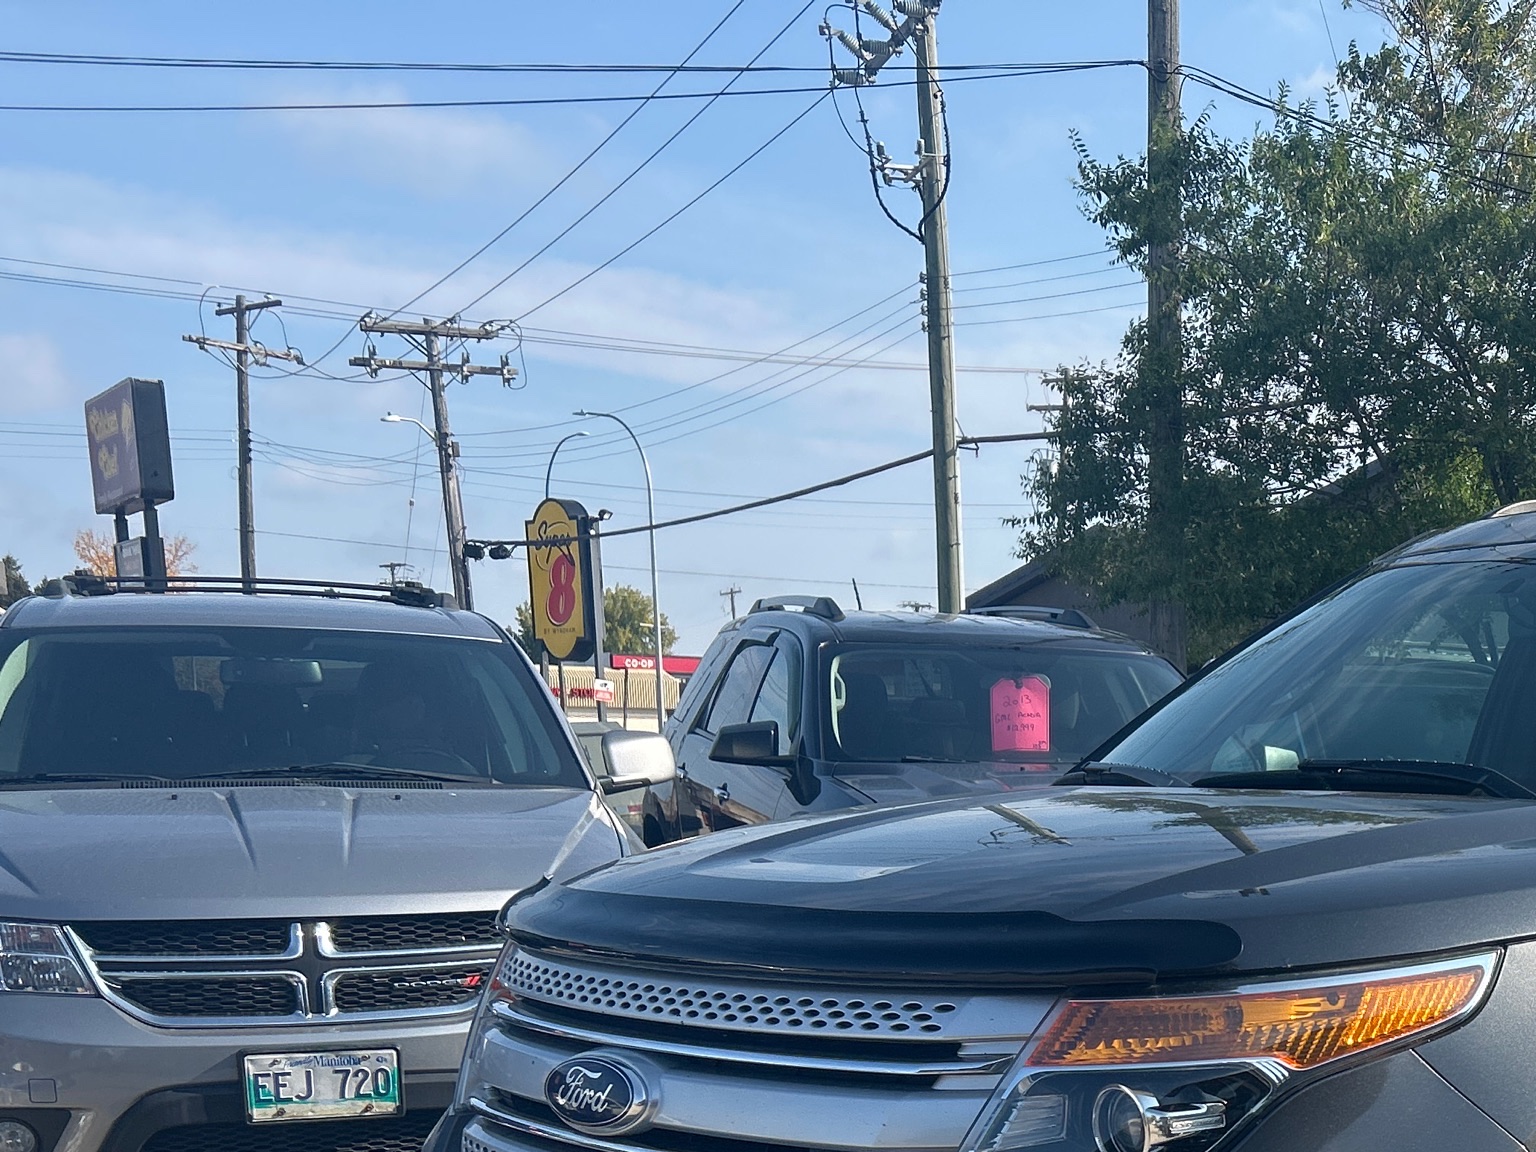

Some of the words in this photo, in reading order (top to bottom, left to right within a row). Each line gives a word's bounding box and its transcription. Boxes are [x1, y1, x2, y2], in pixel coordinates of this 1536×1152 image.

[535, 520, 575, 565] Super
[546, 553, 576, 626] 8
[1003, 694, 1031, 707] 2013
[996, 713, 1011, 724] GMC
[313, 1055, 362, 1067] Manitoba
[253, 1068, 314, 1102] EEJ
[332, 1067, 392, 1099] 720
[556, 1066, 613, 1113] Ford
